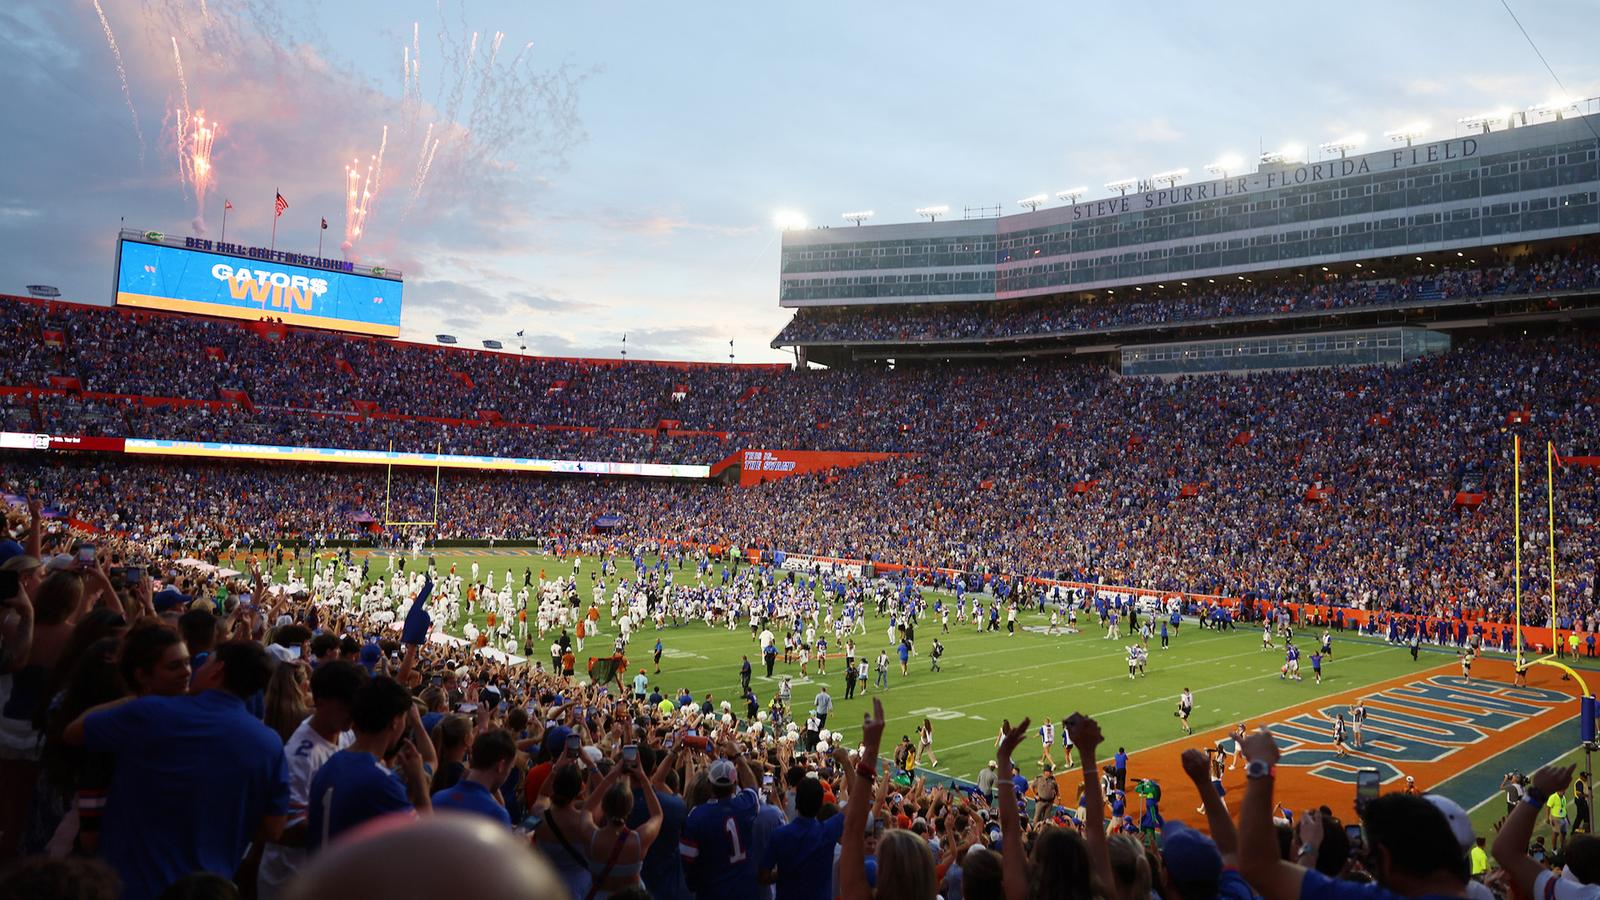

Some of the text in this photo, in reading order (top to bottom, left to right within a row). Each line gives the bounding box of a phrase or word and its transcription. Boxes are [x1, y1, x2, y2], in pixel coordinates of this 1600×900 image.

[1072, 197, 1130, 221] STEVE
[1391, 138, 1480, 169] FIELD
[185, 236, 354, 273] BEN HILL GRIFFIN STADIUM
[211, 263, 329, 297] GATORS
[228, 275, 314, 314] WIN
[295, 739, 314, 758] 2
[725, 817, 747, 864] 1
